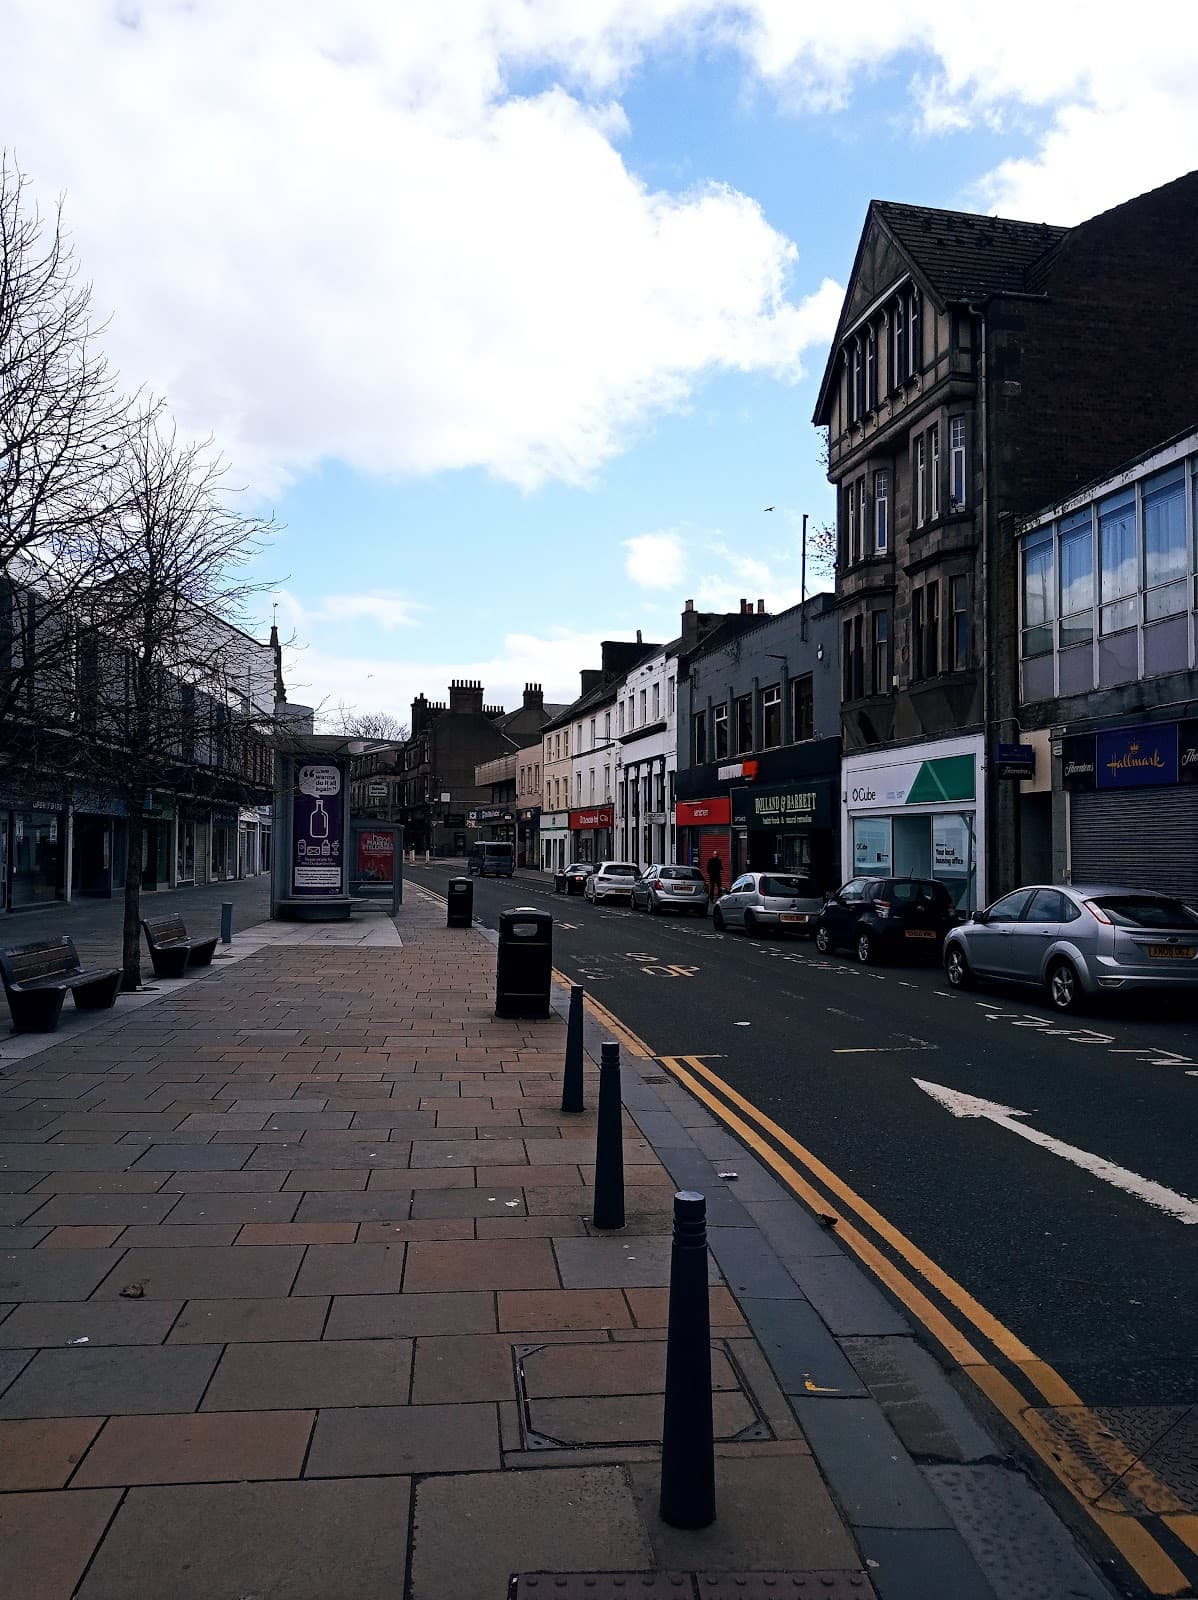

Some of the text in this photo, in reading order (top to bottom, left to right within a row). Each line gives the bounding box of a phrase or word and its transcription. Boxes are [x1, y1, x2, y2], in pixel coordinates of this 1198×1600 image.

[1106, 749, 1166, 777] Hallmark
[1182, 748, 1198, 766] Tho
[754, 792, 817, 814] HOLLAND & BARRETT
